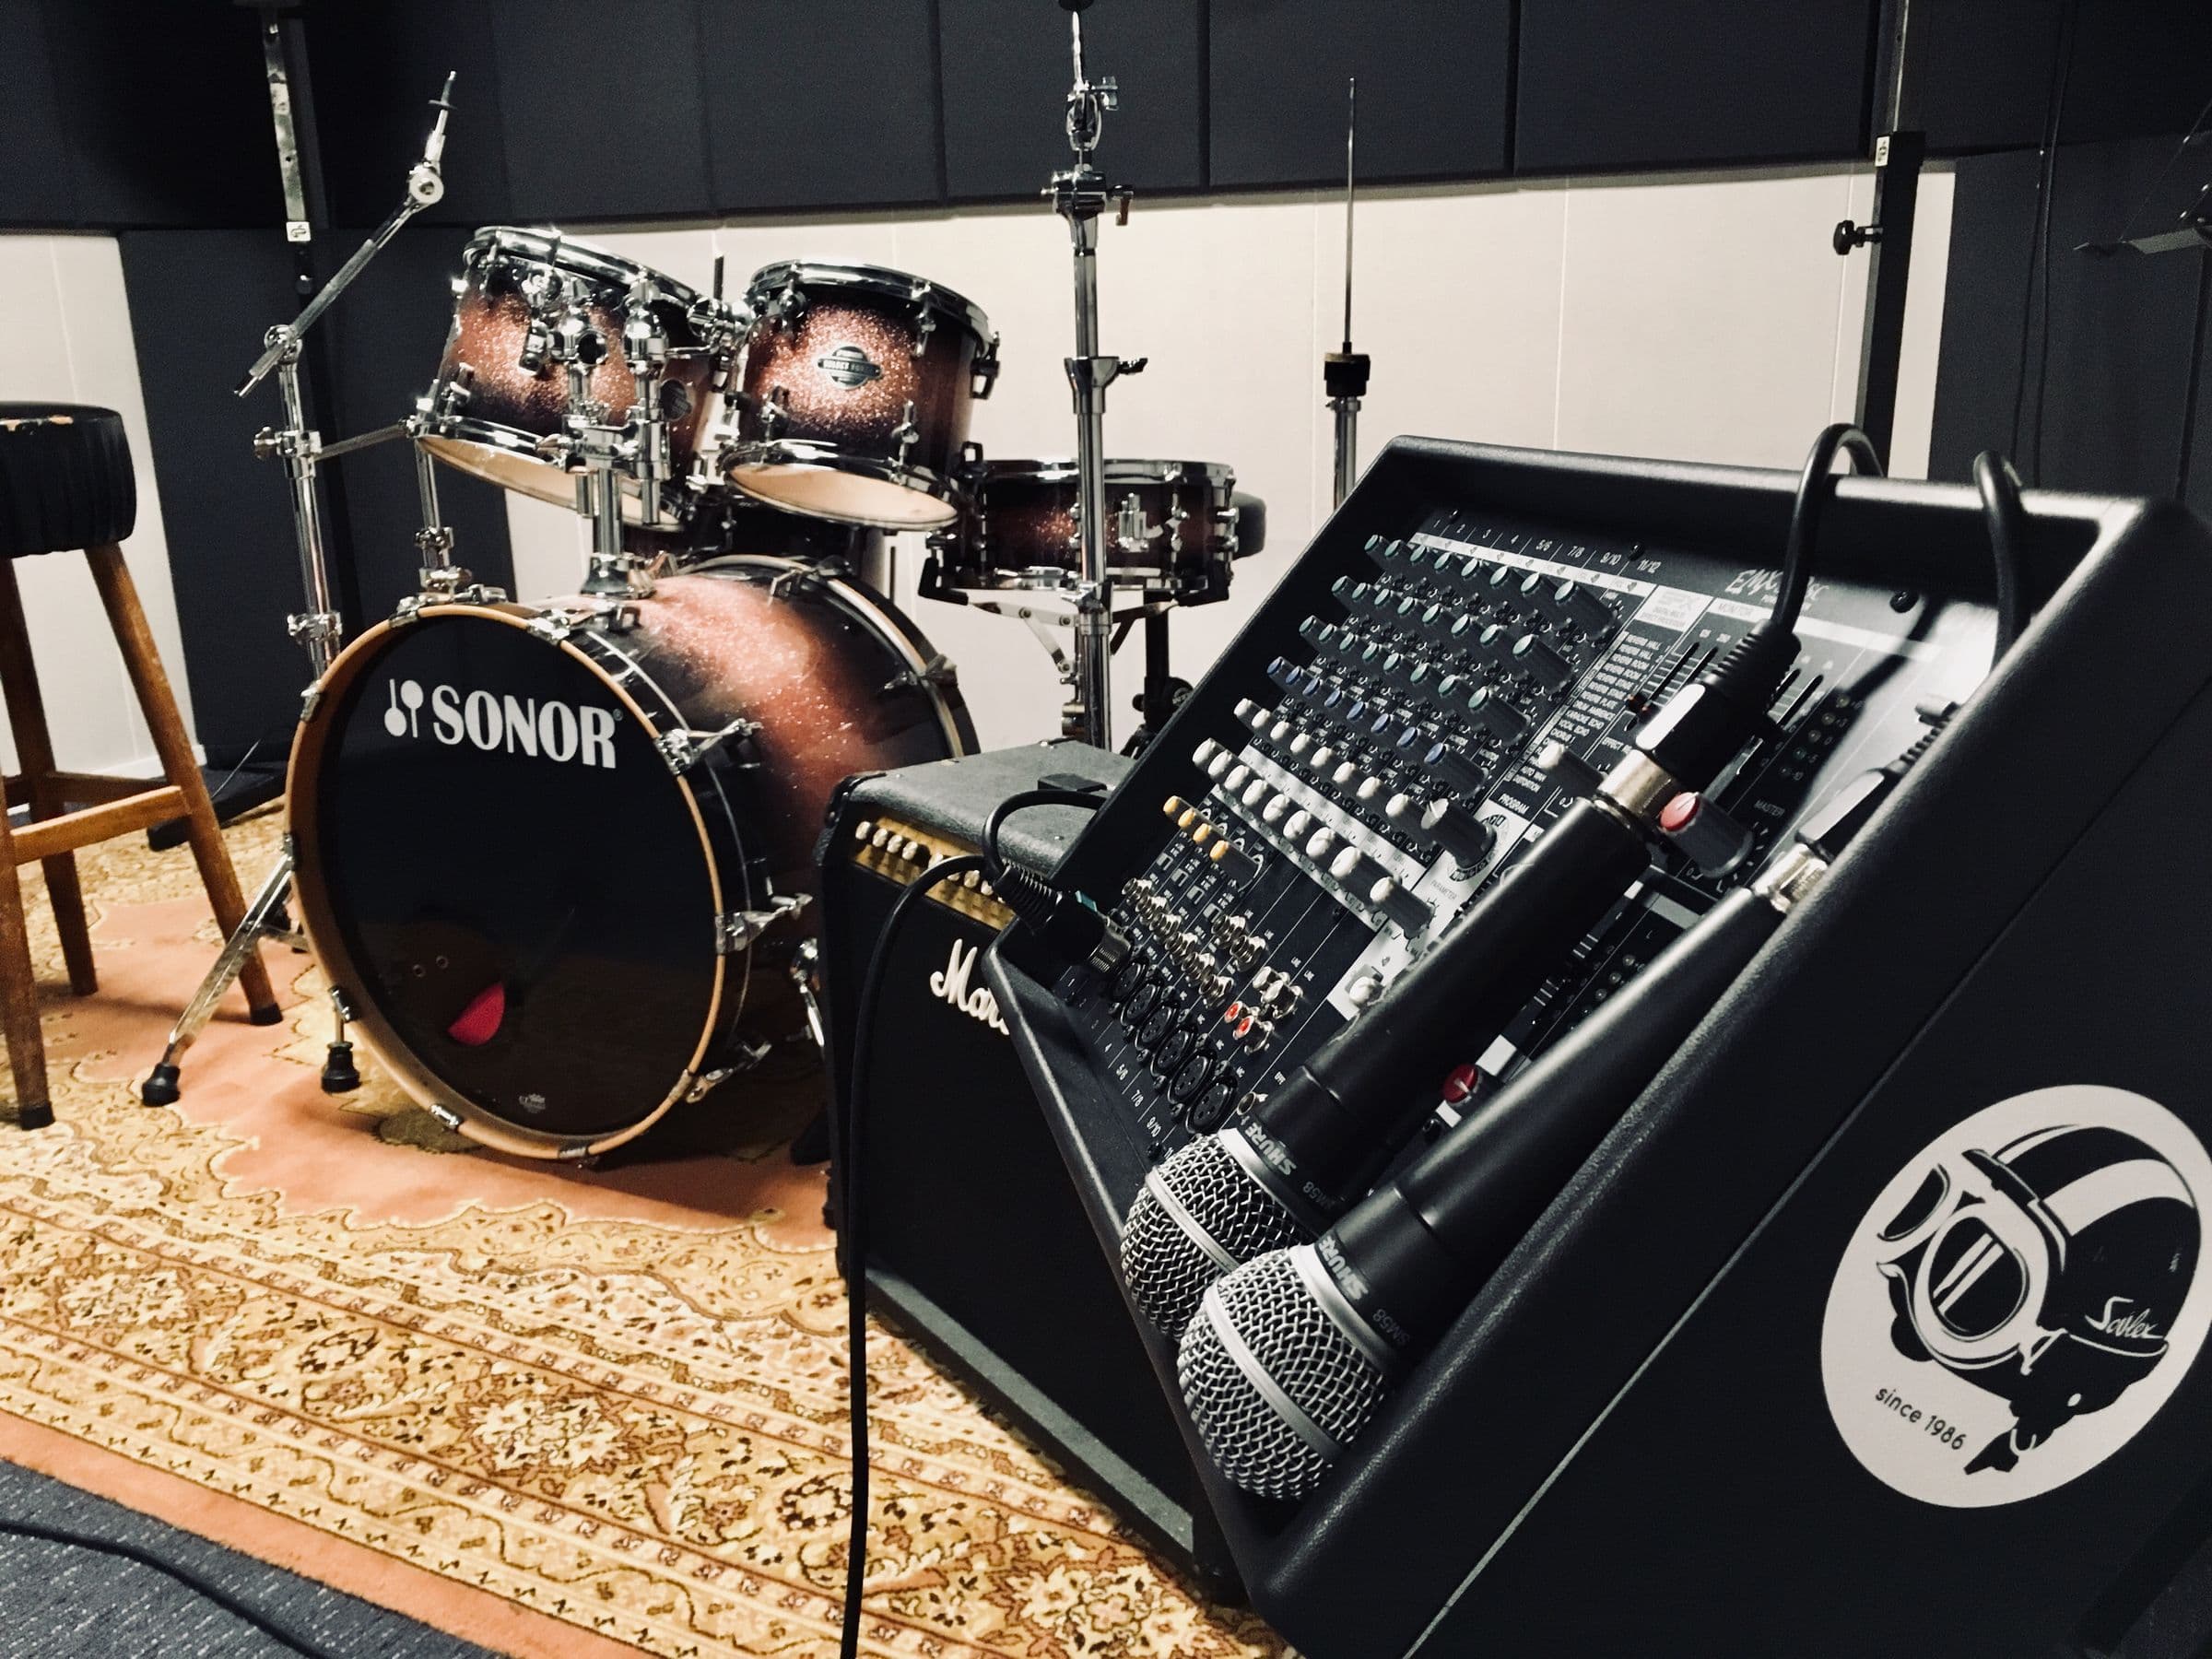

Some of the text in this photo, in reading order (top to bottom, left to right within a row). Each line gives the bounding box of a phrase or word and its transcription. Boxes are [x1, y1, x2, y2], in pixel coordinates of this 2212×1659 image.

[1535, 539, 1553, 551] 5/6
[1567, 546, 1585, 559] 7/8
[1599, 551, 1622, 566] 9/10
[1636, 559, 1662, 573] 11/12
[431, 684, 617, 769] SONOR
[1498, 793, 1530, 816] PROGRAM
[1754, 799, 1785, 818] MASTER
[1430, 879, 1457, 900] PARAMETER
[1115, 1063, 1129, 1081] 5/6
[1130, 1088, 1145, 1108] 7/8
[1146, 1115, 1162, 1137] 9/10
[1244, 1122, 1297, 1176] SHURE
[1318, 1235, 1370, 1301] SHURE
[1875, 1387, 1967, 1451] since 1986
